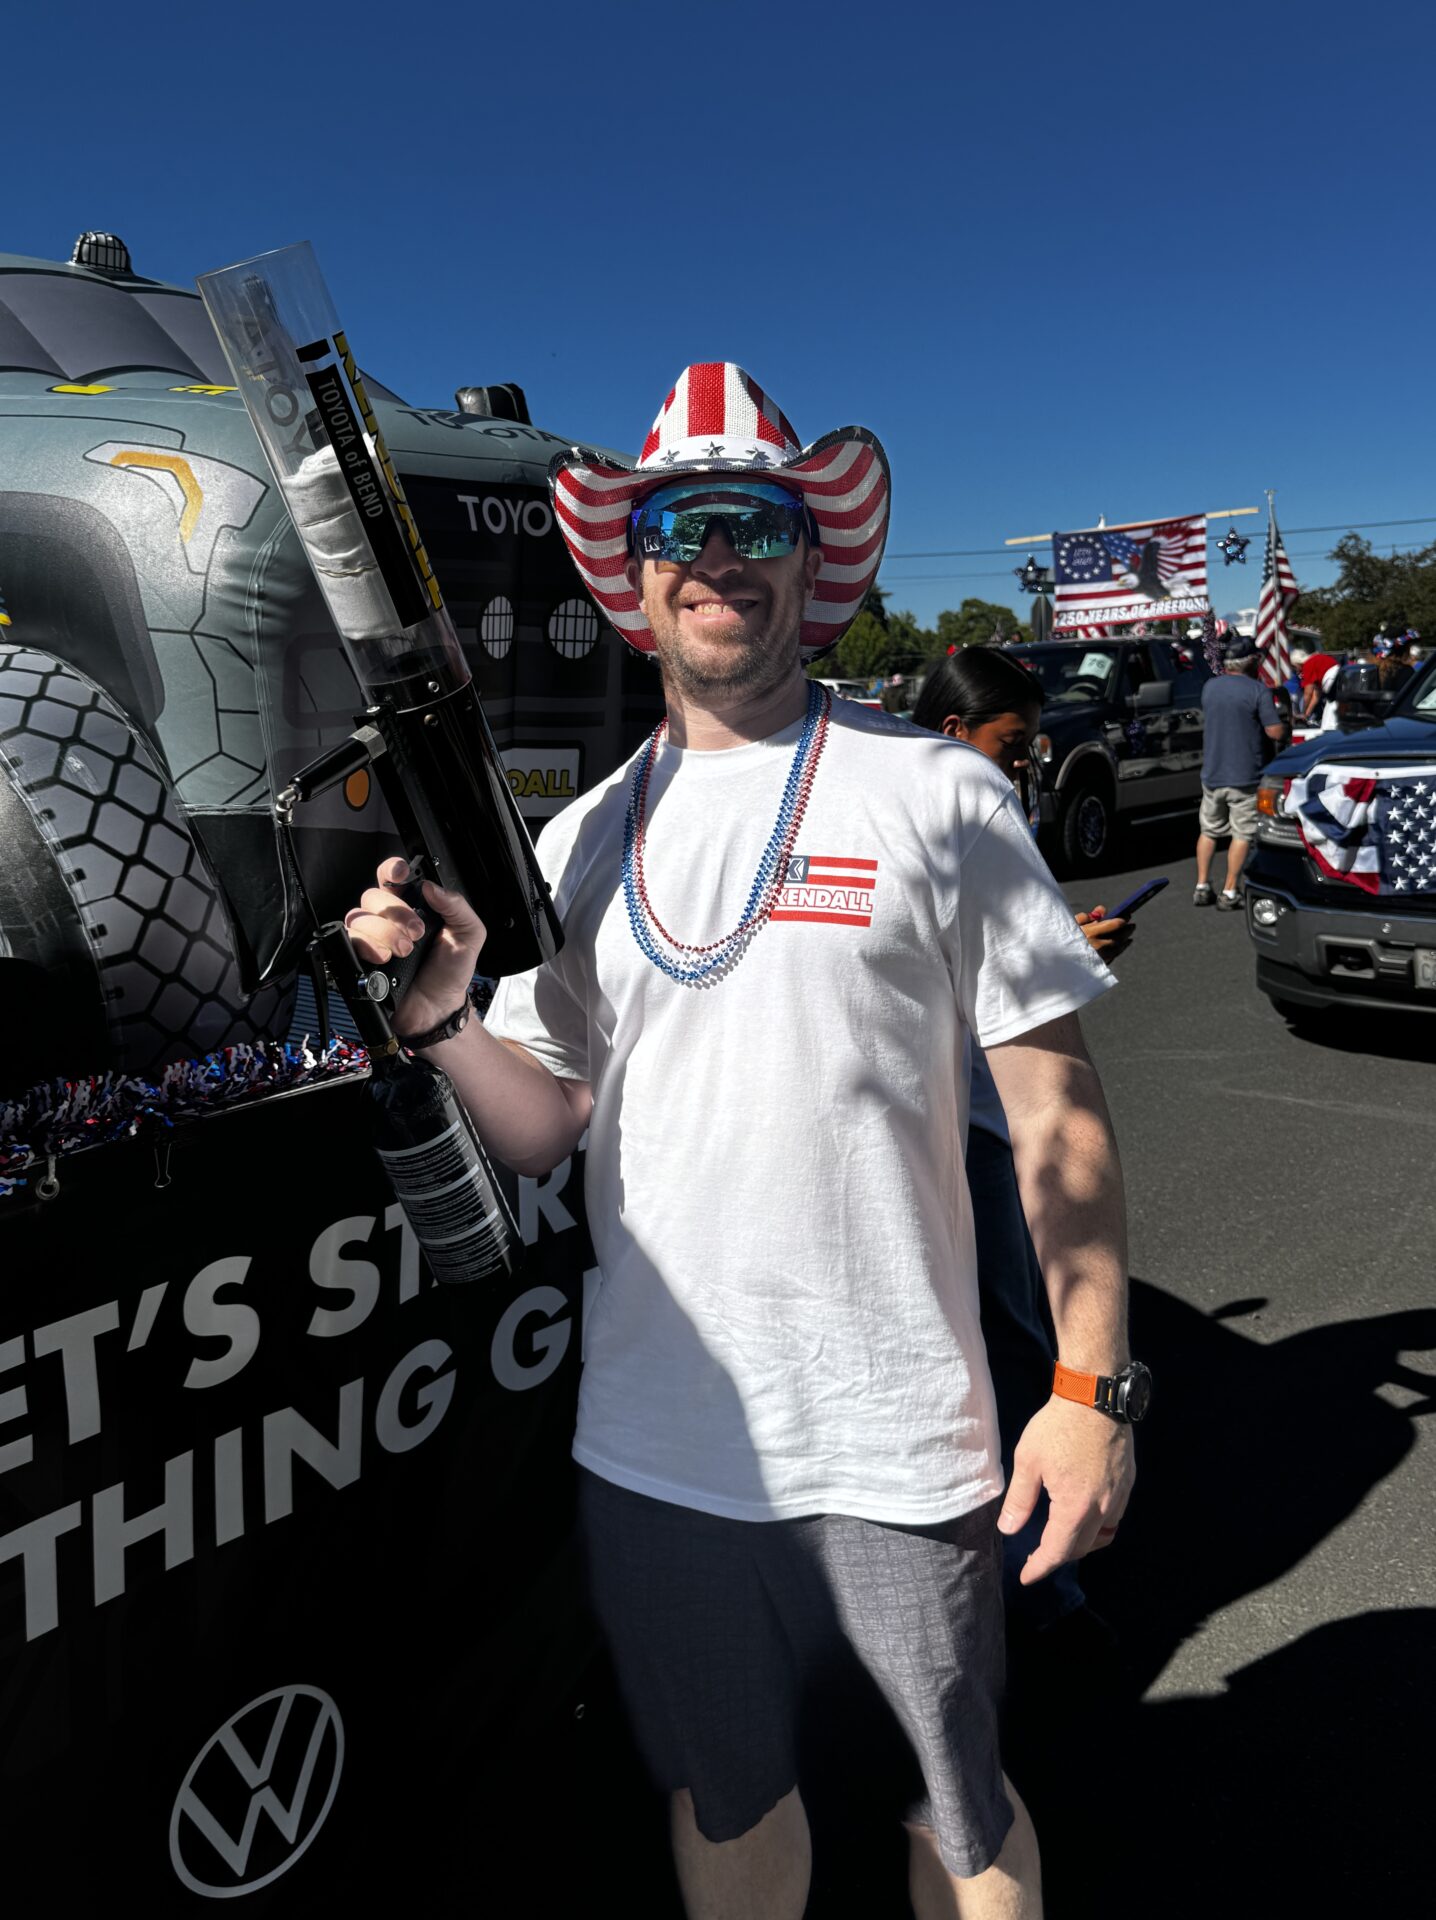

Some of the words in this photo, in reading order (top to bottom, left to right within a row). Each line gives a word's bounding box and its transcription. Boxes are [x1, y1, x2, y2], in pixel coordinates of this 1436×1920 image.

[317, 377, 355, 449] TOYOTA
[344, 450, 367, 471] of
[352, 470, 384, 519] BEND
[1058, 611, 1085, 627] 250
[1087, 607, 1129, 624] YEARS
